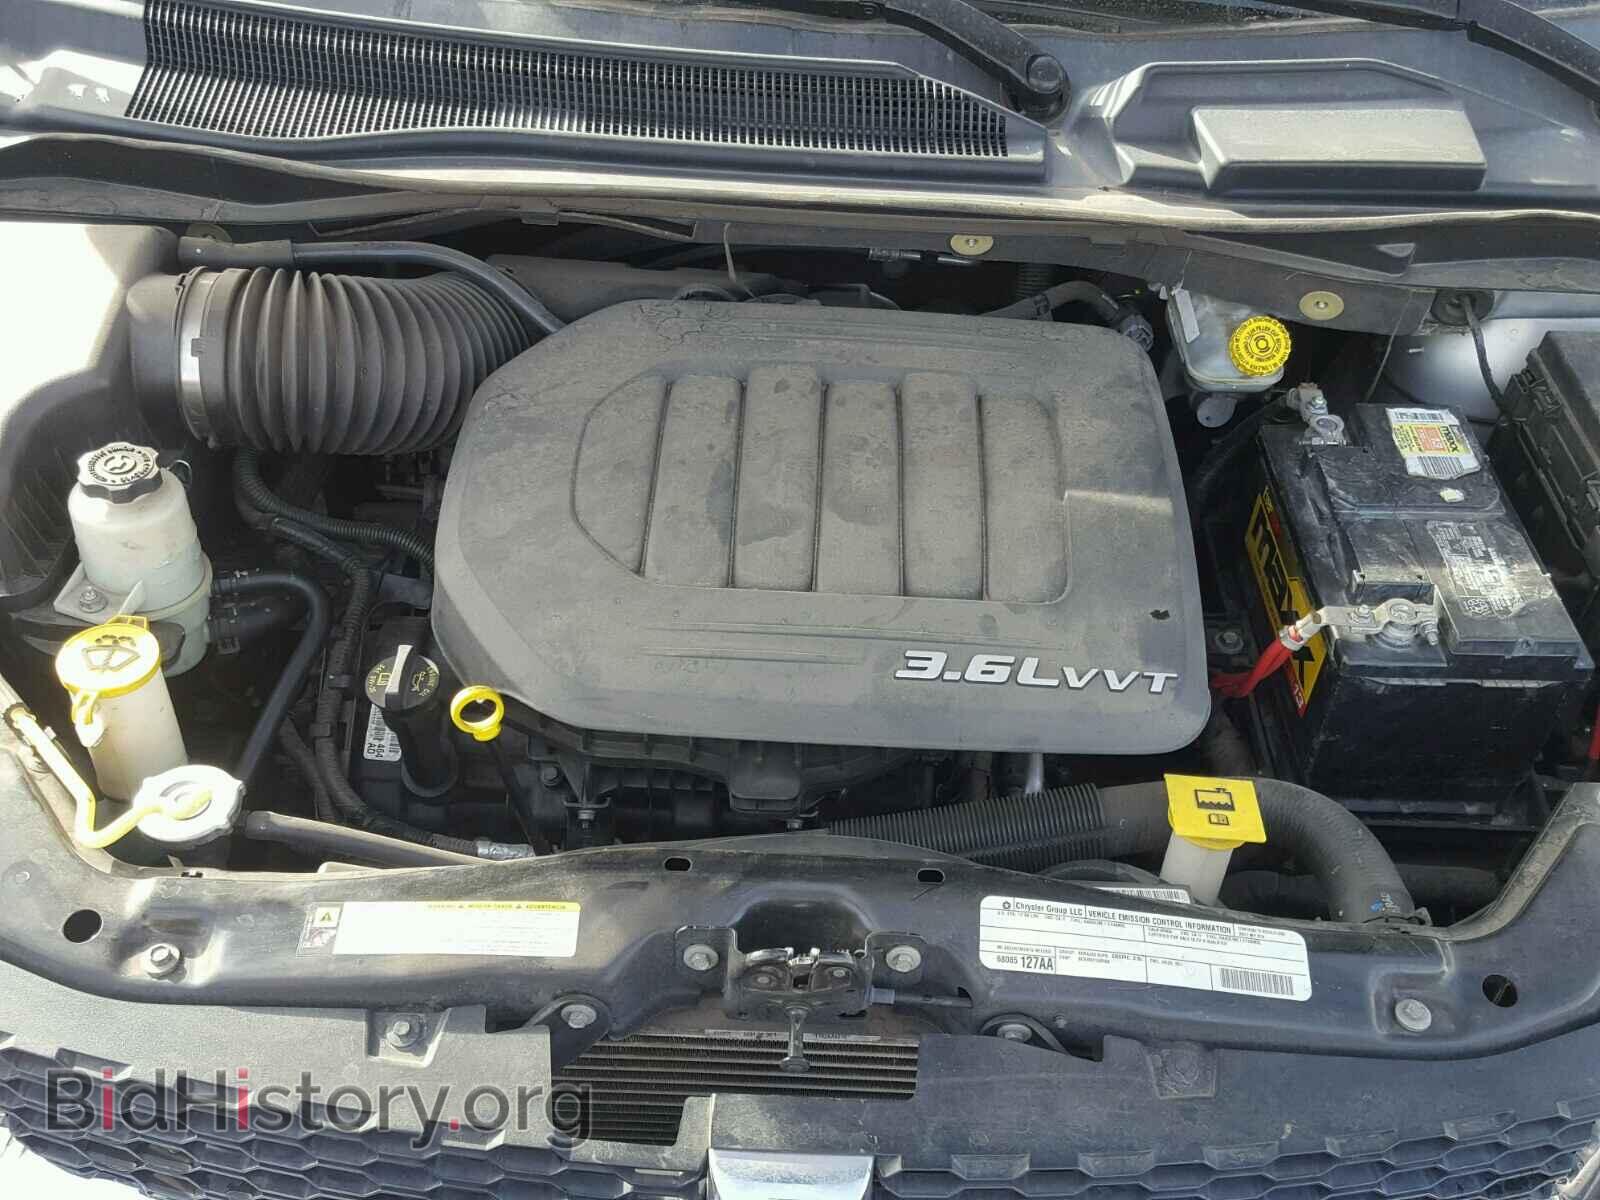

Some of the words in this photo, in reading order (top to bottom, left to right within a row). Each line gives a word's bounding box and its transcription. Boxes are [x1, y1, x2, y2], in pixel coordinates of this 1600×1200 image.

[894, 649, 1060, 687] 3.6L
[1061, 666, 1179, 694] VVT
[1015, 901, 1045, 912] Chrysler
[1046, 904, 1068, 915] Group
[1069, 907, 1083, 916] LLC
[1087, 910, 1116, 920] VEHICLE
[1118, 913, 1150, 923] EMISSION
[1152, 917, 1183, 928] CONTROL
[1185, 921, 1232, 934] INFORMATION
[1020, 956, 1054, 970] 127AA
